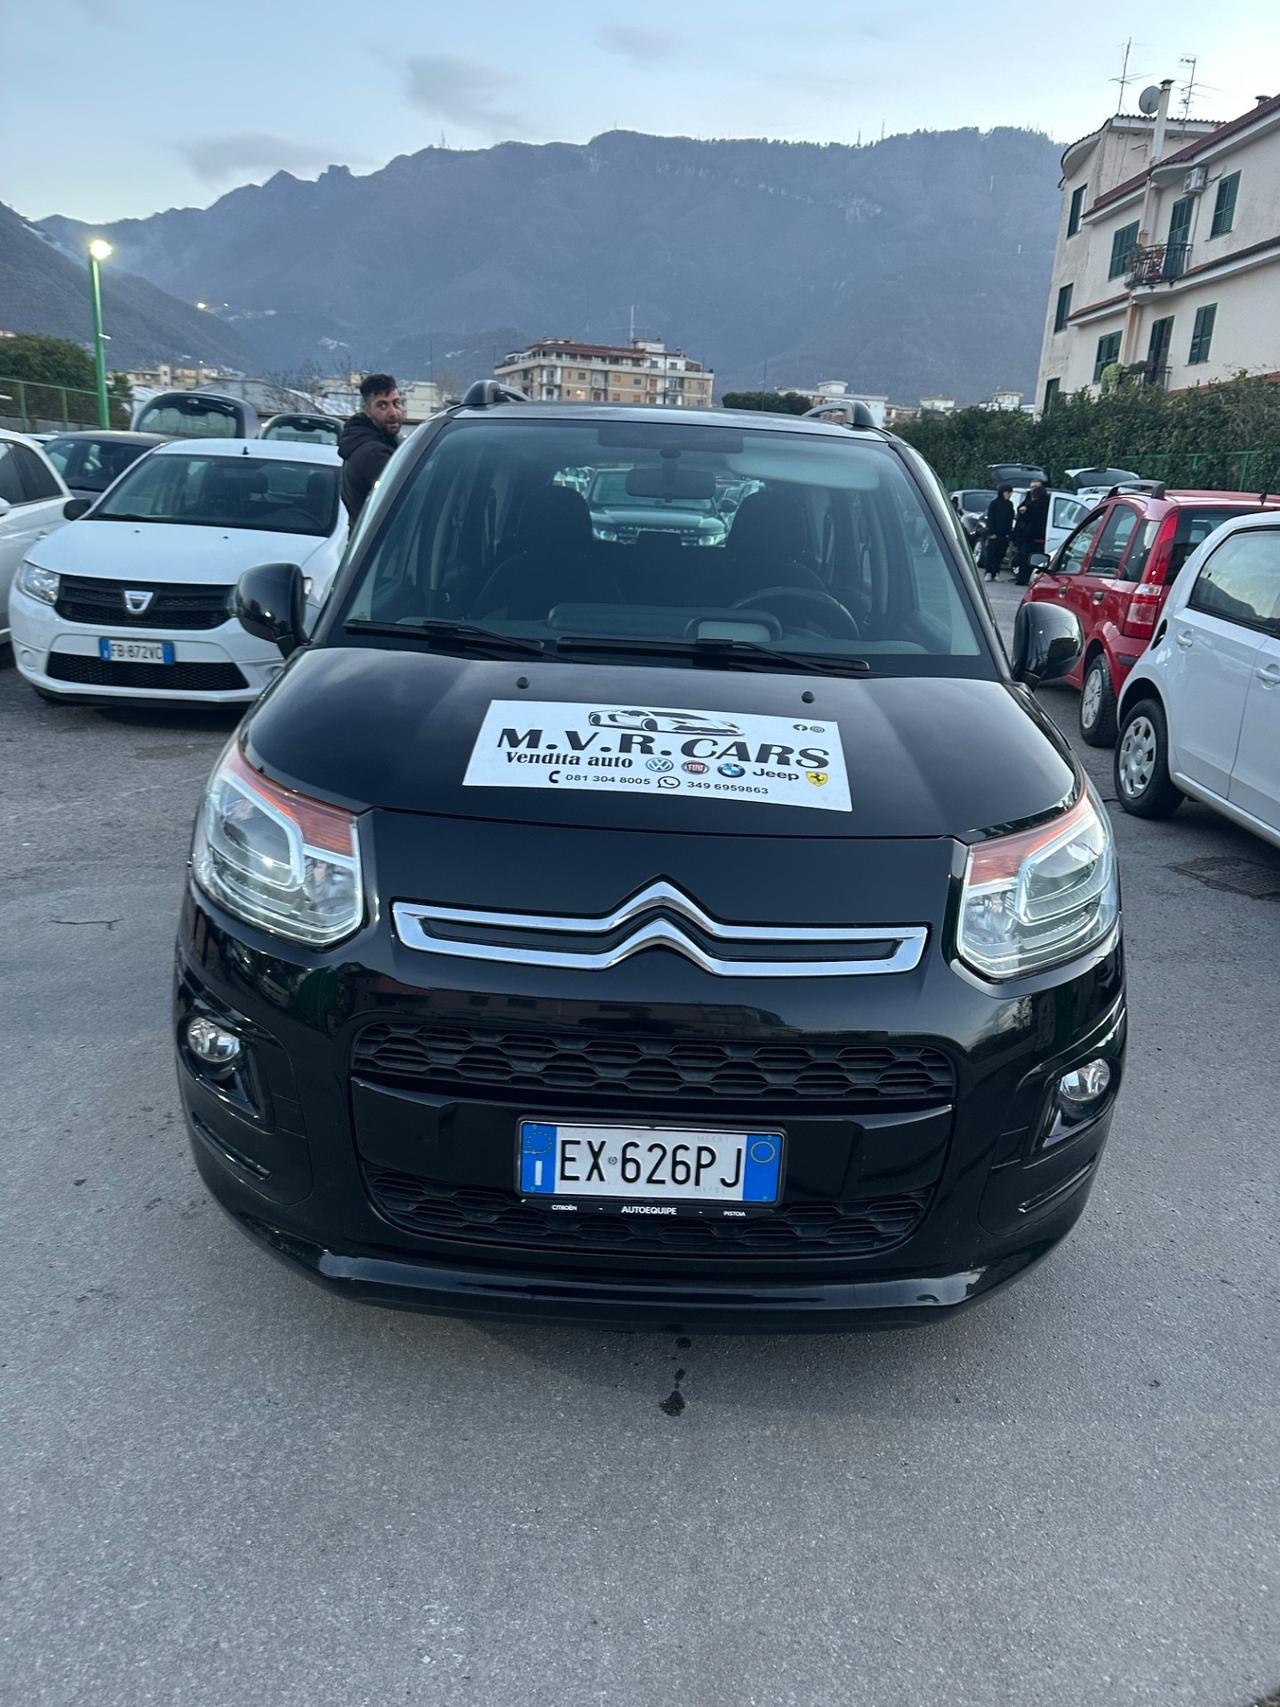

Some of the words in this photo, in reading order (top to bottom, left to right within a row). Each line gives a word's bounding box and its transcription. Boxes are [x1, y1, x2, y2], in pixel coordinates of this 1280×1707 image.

[506, 751, 580, 766] Vendita
[587, 756, 633, 768] auto
[565, 774, 588, 782] 081
[592, 775, 616, 783] 304
[619, 777, 651, 785] 8005
[752, 768, 800, 781] Jeep
[687, 781, 711, 789] 349
[560, 1139, 607, 1182] EX
[621, 1141, 742, 1188] 626PJ
[621, 1205, 677, 1215] AUTOEQUIPE
